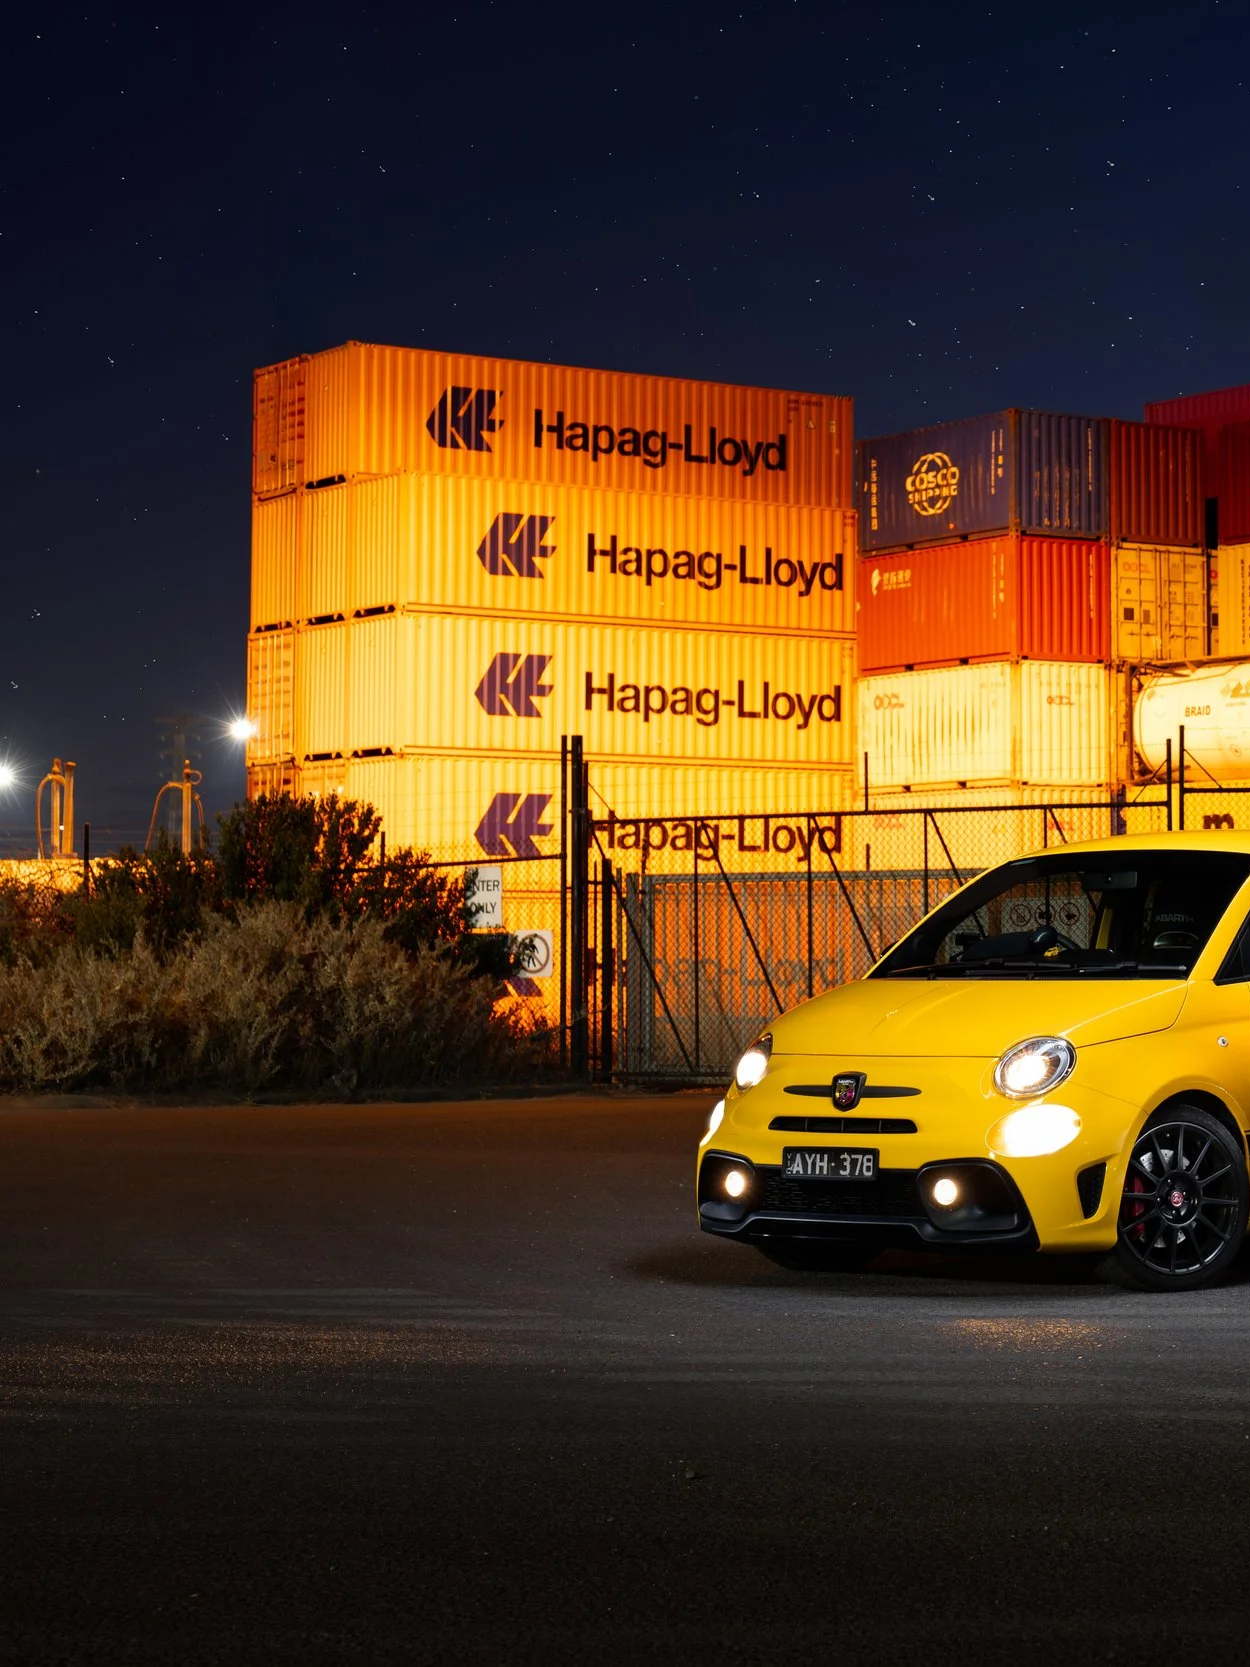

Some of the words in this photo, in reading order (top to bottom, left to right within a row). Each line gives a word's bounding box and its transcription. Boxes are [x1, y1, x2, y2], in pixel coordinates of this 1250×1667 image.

[534, 408, 787, 477] Hapag-Lloyd
[905, 466, 960, 492] COSCO
[908, 485, 958, 504] SHIPPING
[587, 533, 844, 597] Hapag-Lloyd
[584, 672, 842, 730] Hapag-Lloyd
[1184, 705, 1212, 717] BRAID
[468, 879, 500, 892] NTER
